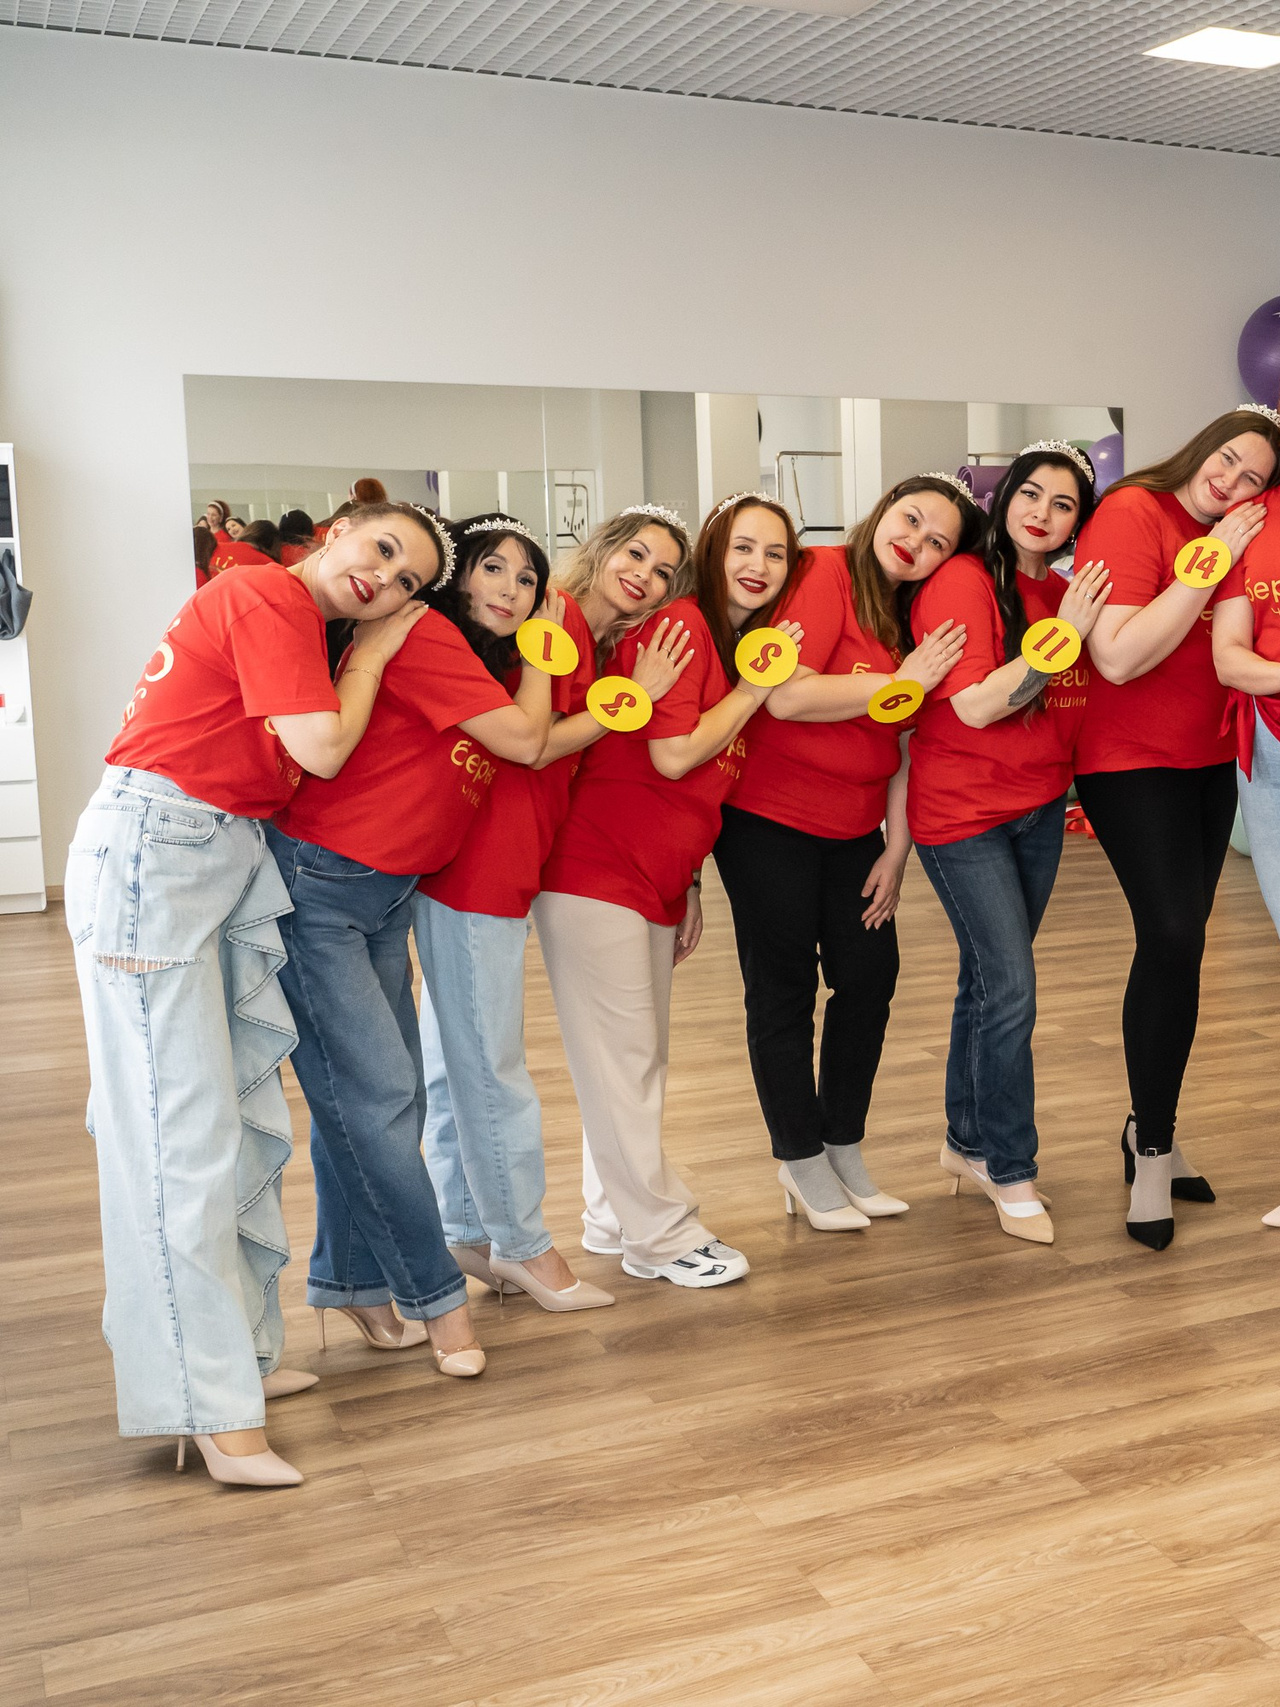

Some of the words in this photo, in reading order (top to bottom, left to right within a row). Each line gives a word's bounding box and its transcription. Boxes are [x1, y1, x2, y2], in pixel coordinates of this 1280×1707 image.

[1183, 545, 1219, 580] 14
[542, 631, 553, 662] 1
[1032, 626, 1071, 662] 11
